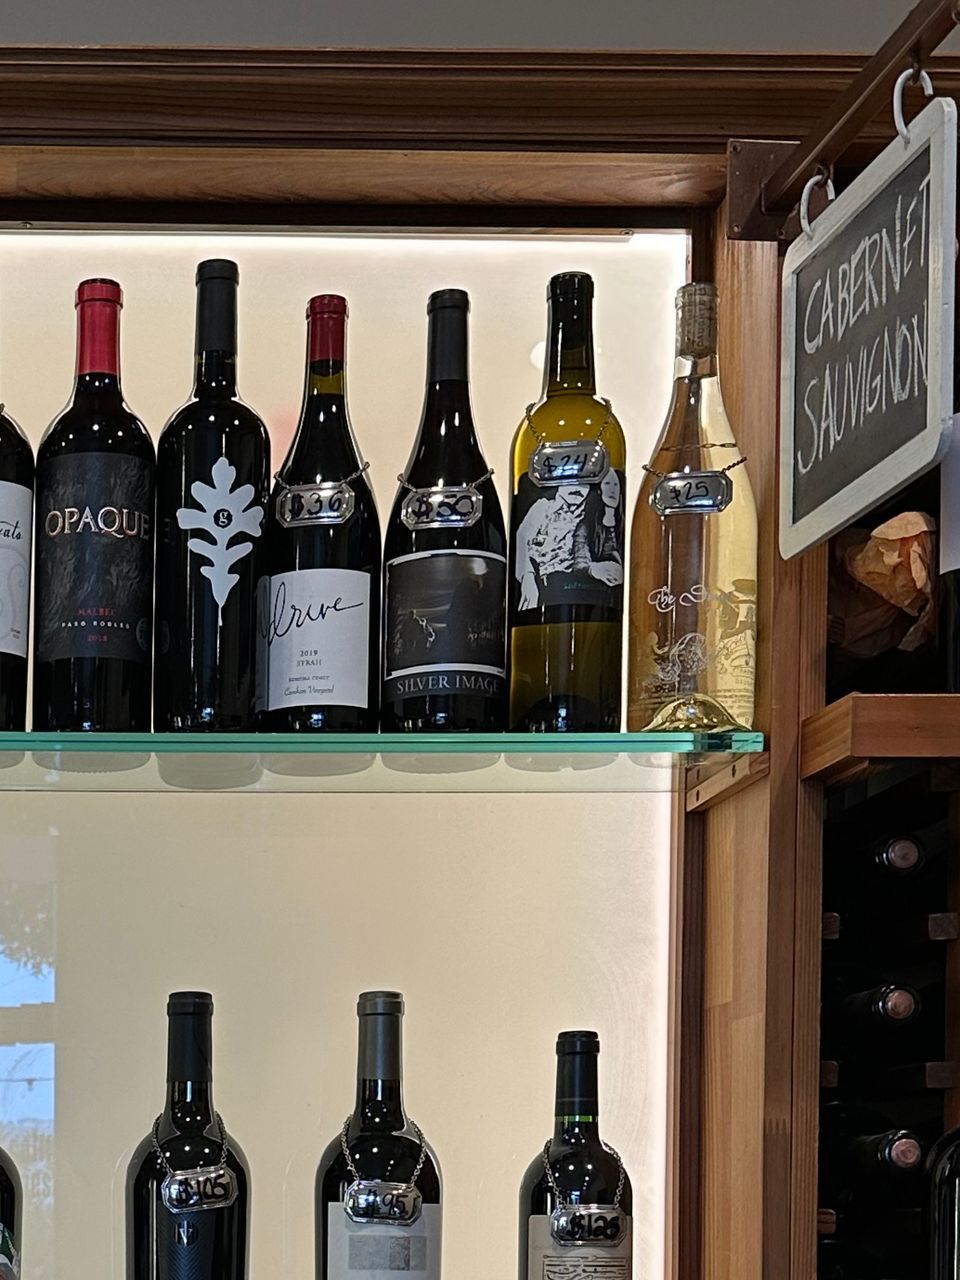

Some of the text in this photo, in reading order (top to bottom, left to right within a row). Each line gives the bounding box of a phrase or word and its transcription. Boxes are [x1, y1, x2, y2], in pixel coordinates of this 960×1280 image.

[803, 173, 931, 354] CABERNET
[797, 299, 929, 474] SAUVIGNON
[542, 454, 587, 474] $24
[670, 481, 709, 502] $25
[290, 491, 344, 518] $36
[45, 506, 149, 540] OPAQUE
[92, 620, 130, 630] ROBLES
[397, 674, 498, 694] SILVER IMAGE
